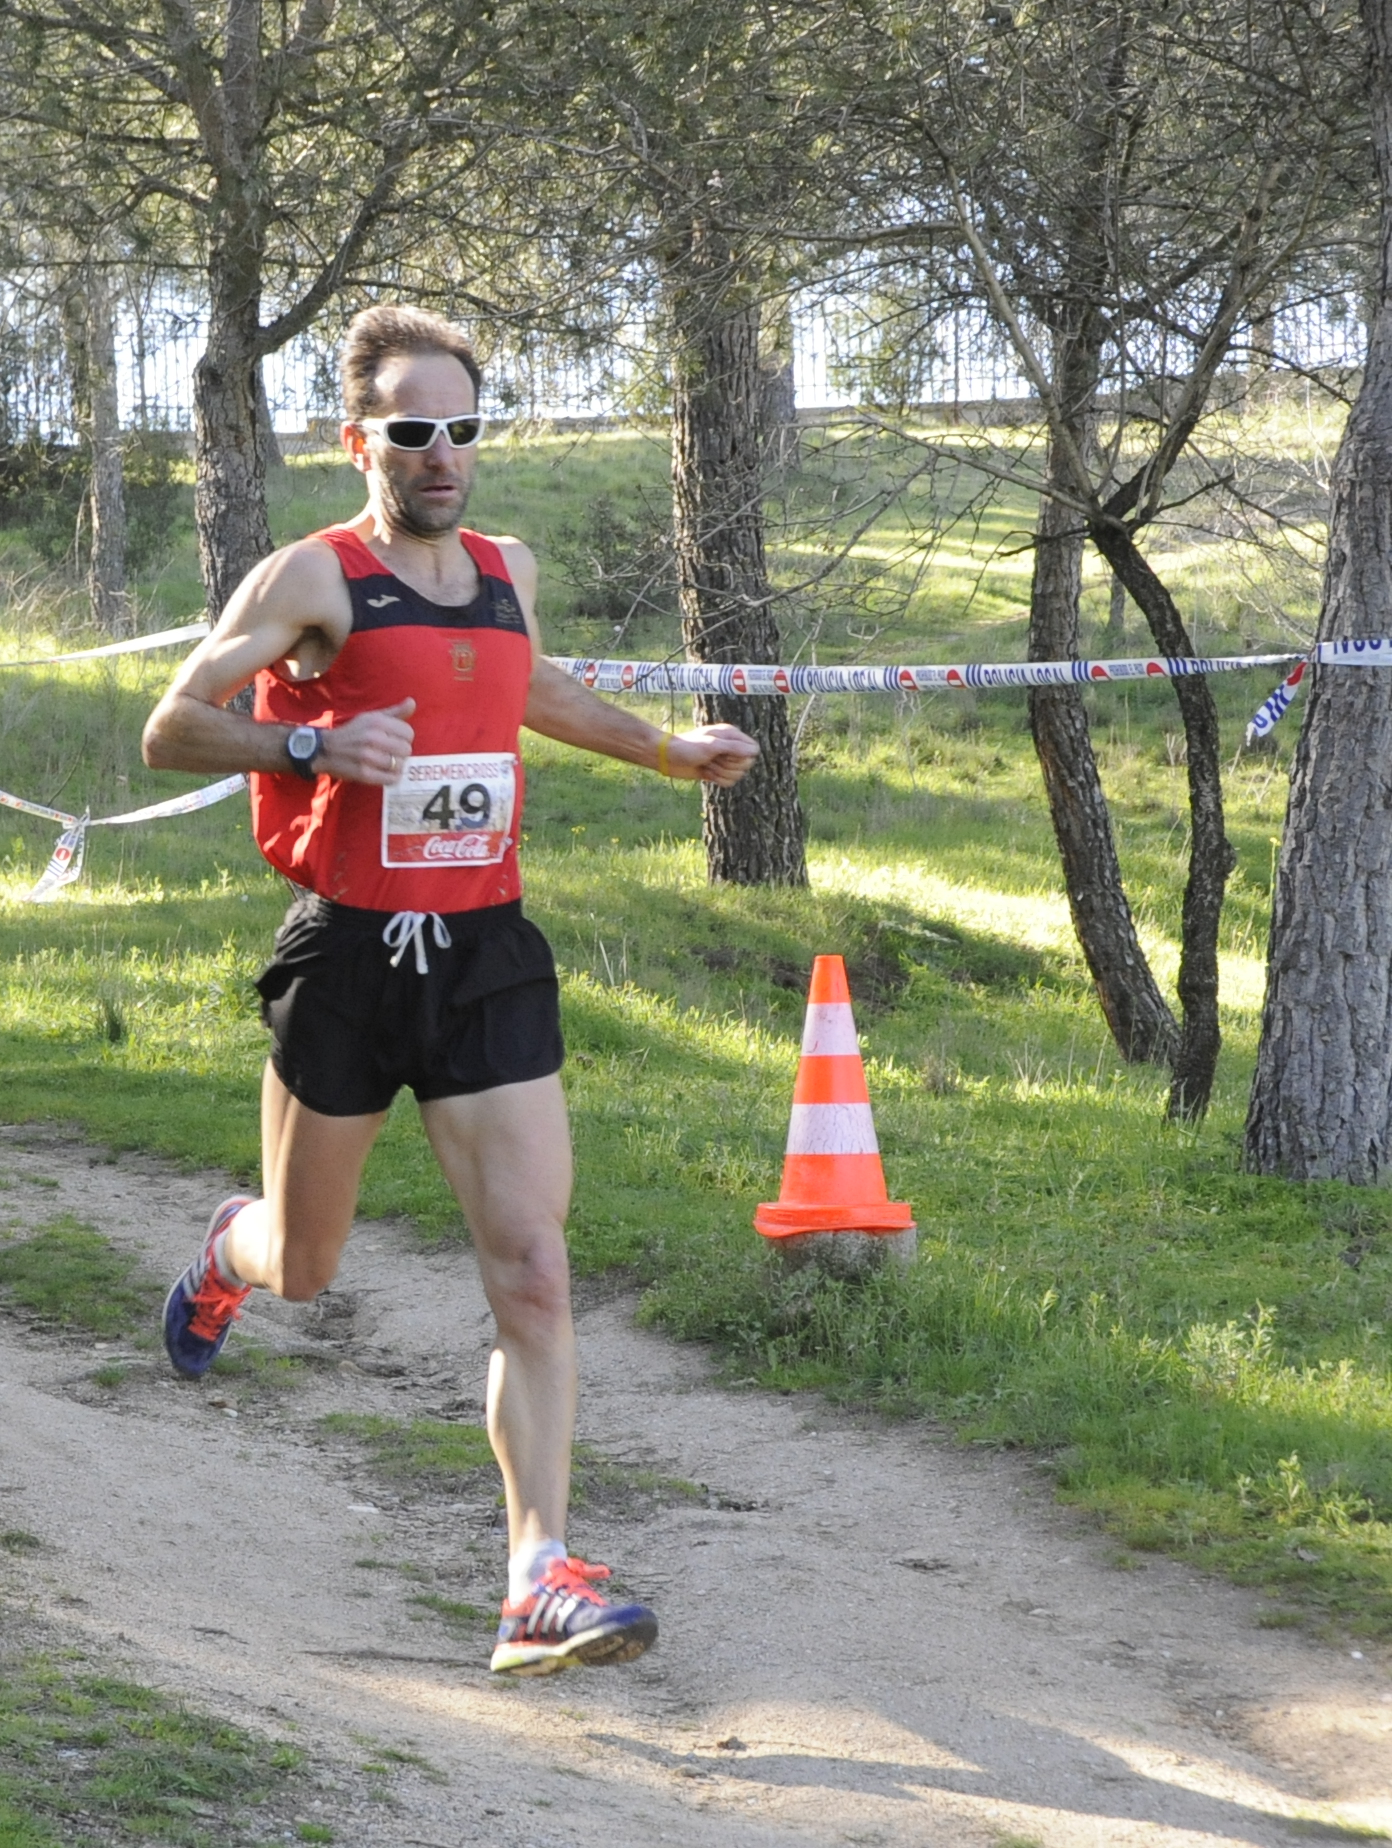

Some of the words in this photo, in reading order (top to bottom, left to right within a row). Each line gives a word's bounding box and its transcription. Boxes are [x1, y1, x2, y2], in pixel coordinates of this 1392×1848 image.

[808, 670, 848, 693] POLICIA
[849, 670, 880, 692] LOCAL
[984, 667, 1030, 687] POLICIA
[422, 783, 491, 830] 49
